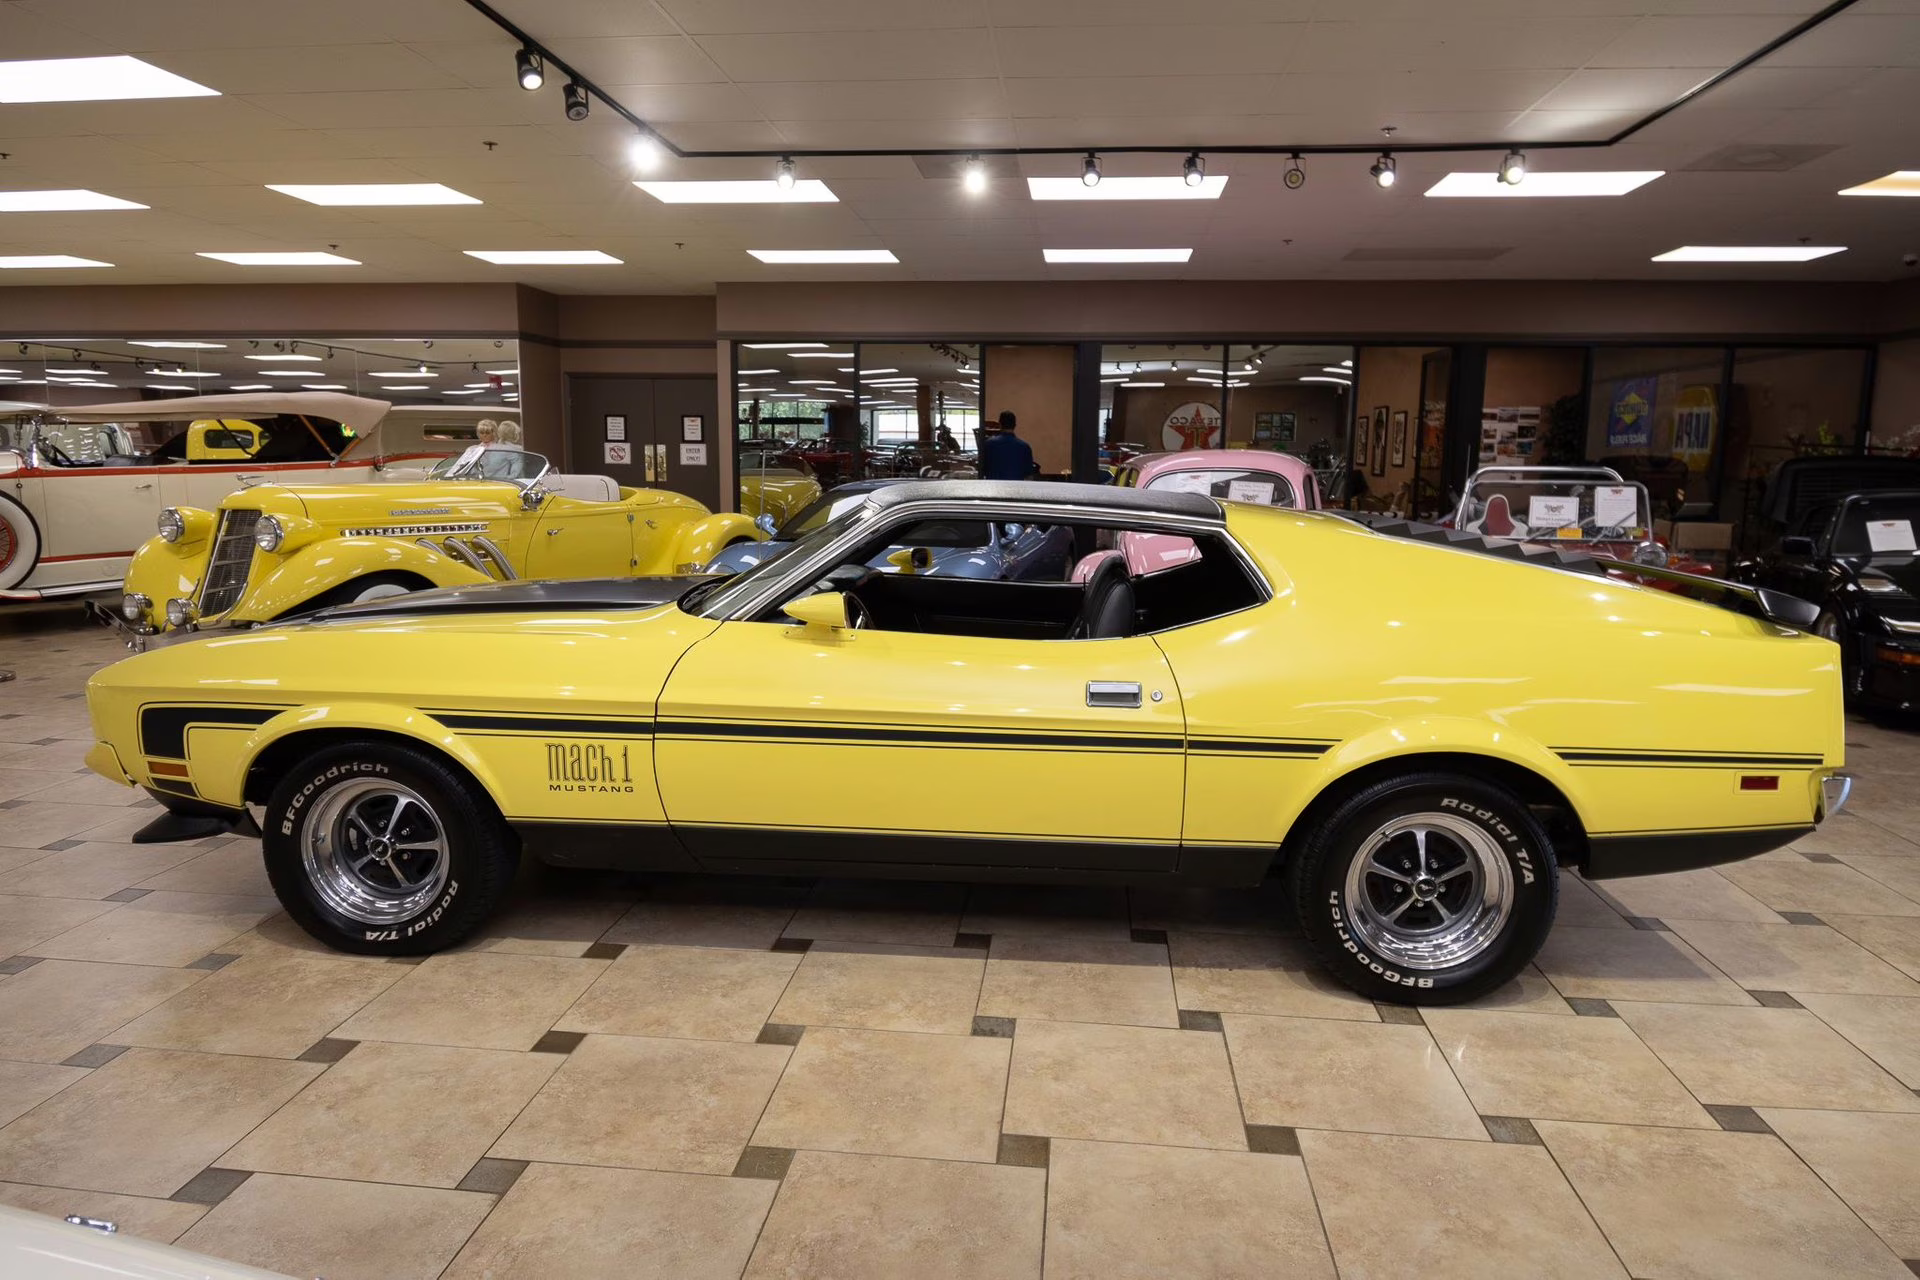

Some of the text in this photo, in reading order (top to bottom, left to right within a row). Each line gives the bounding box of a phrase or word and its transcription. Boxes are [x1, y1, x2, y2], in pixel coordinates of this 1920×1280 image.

[549, 784, 634, 793] MUSTANG
[622, 744, 633, 783] 1
[282, 762, 389, 836] BFGoodrich
[1440, 797, 1535, 885] Radial T/A
[365, 880, 459, 941] Radial T/A
[1329, 891, 1434, 989] BFGoodrich
